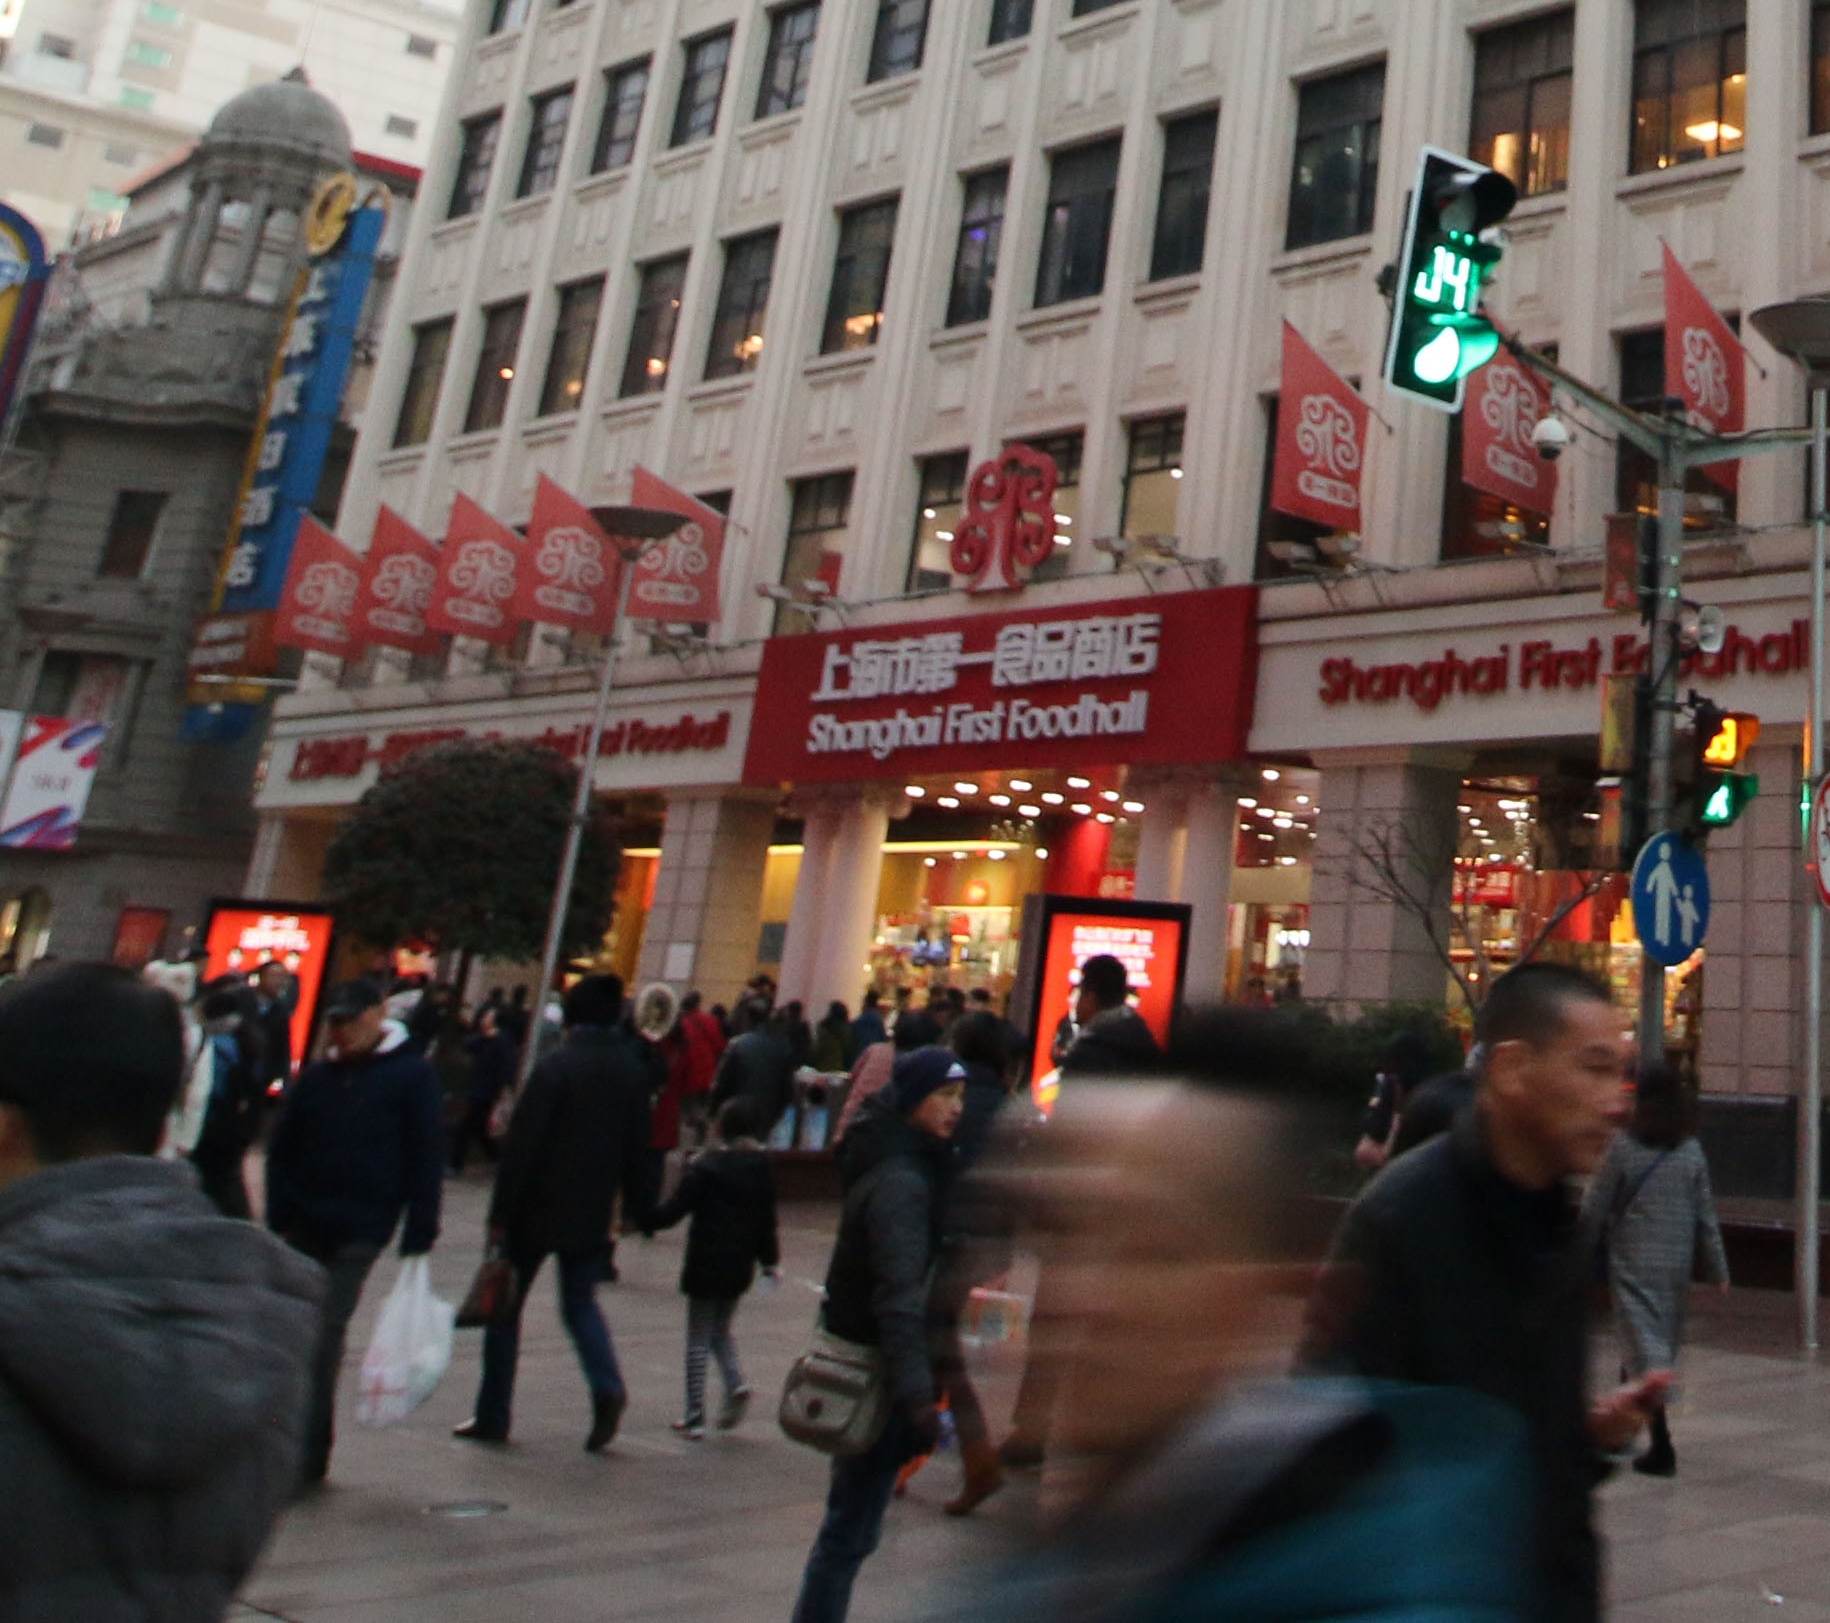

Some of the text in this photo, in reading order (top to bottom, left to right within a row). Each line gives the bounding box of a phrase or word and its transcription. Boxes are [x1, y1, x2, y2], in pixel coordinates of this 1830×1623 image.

[810, 612, 1163, 703] 上海市第一食品商店
[1319, 643, 1509, 713] Shanghai
[1519, 635, 1602, 690] First
[806, 689, 1150, 760] Shanghai First Foodhall
